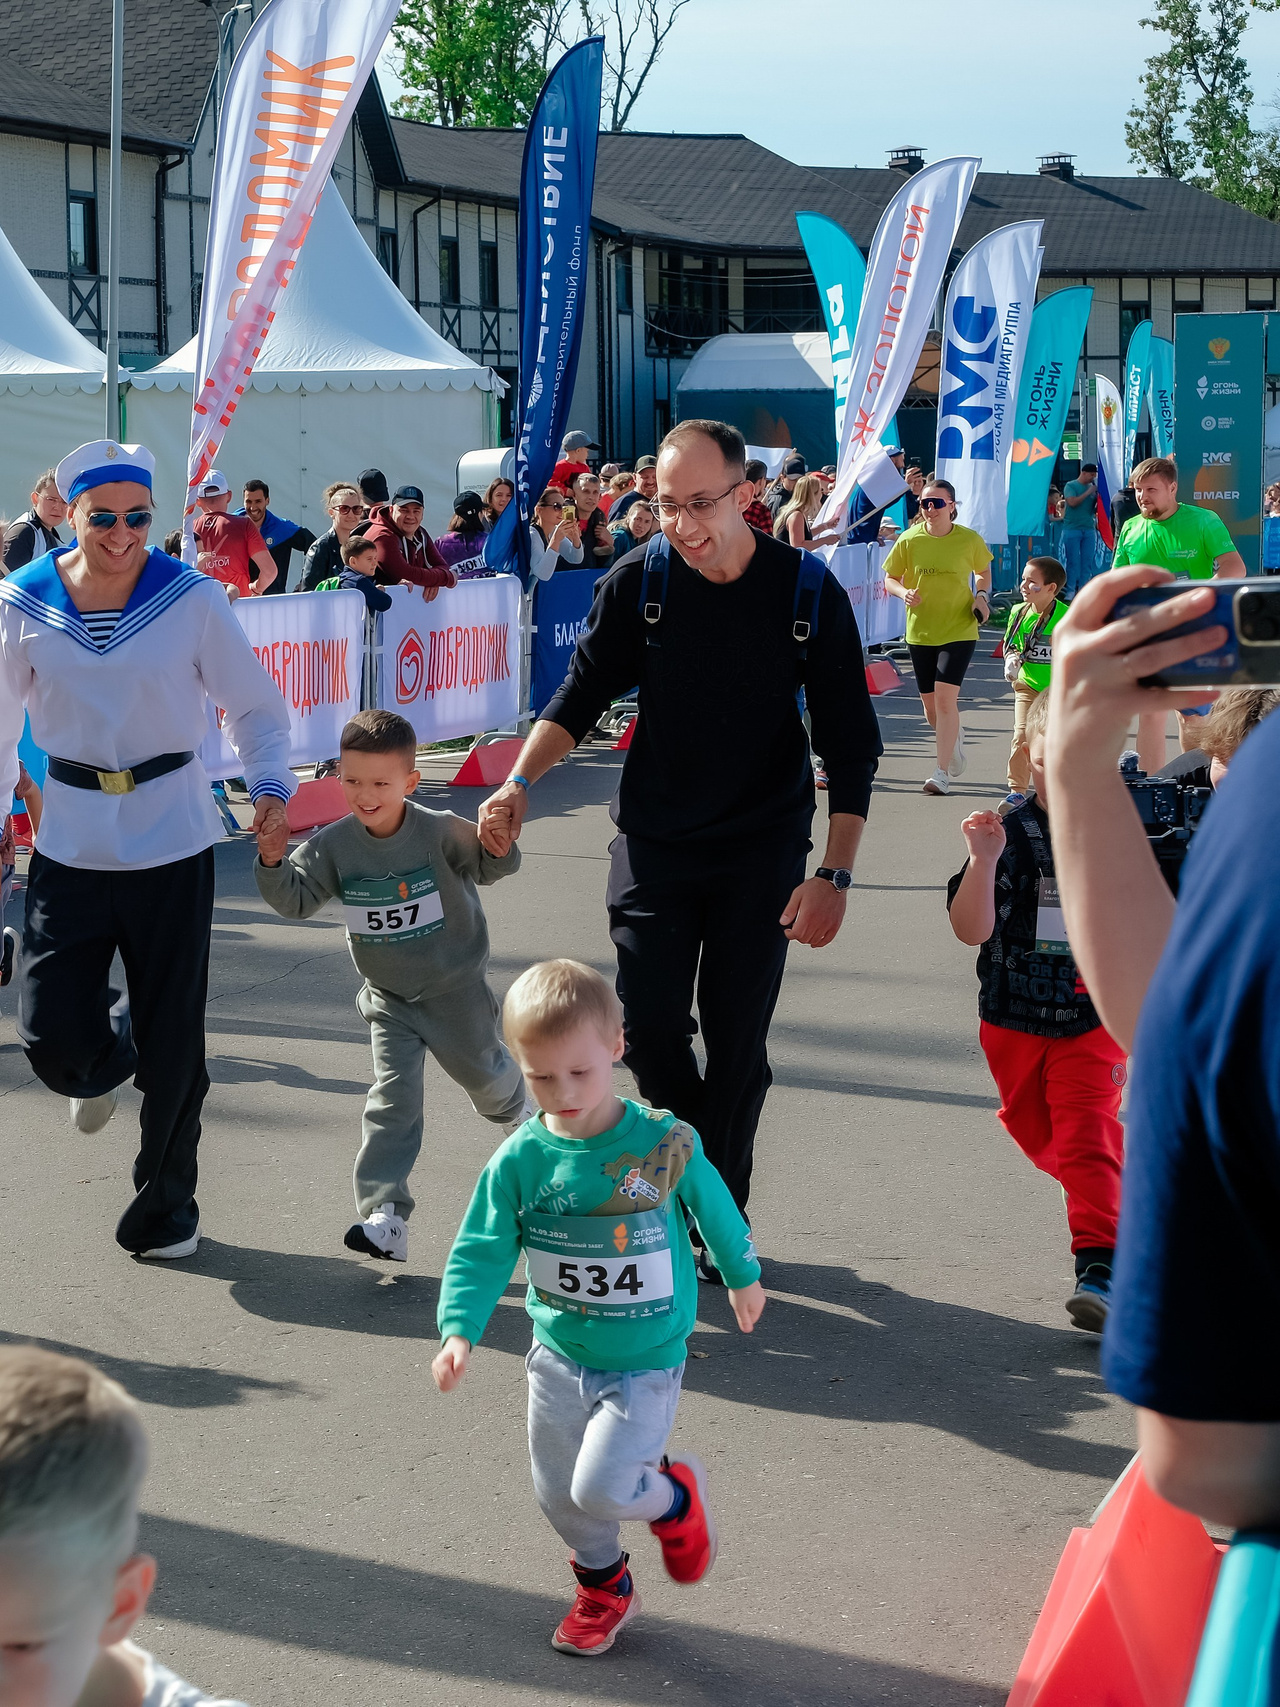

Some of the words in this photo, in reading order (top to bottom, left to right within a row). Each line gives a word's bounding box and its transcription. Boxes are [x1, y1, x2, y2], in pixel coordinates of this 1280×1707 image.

[994, 301, 1021, 400] МЕДИАГРУППА
[938, 295, 999, 460] RMG
[1026, 364, 1046, 426] ОГОНЬ
[1038, 361, 1063, 430] ЖИЗНИ
[1203, 491, 1240, 500] MAER
[554, 622, 581, 647] БЛАГ
[425, 622, 511, 701] ДОБРОДОМИК
[1031, 645, 1052, 659] 54
[366, 903, 420, 931] 557
[528, 1226, 569, 1240] 14.09.2025
[529, 1235, 587, 1249] БЛАГОТВОРИТЕЛЬНЫЙ
[632, 1234, 665, 1246] ЖИЗНИ
[633, 1226, 662, 1238] ОГОНЬ
[558, 1261, 643, 1297] 534
